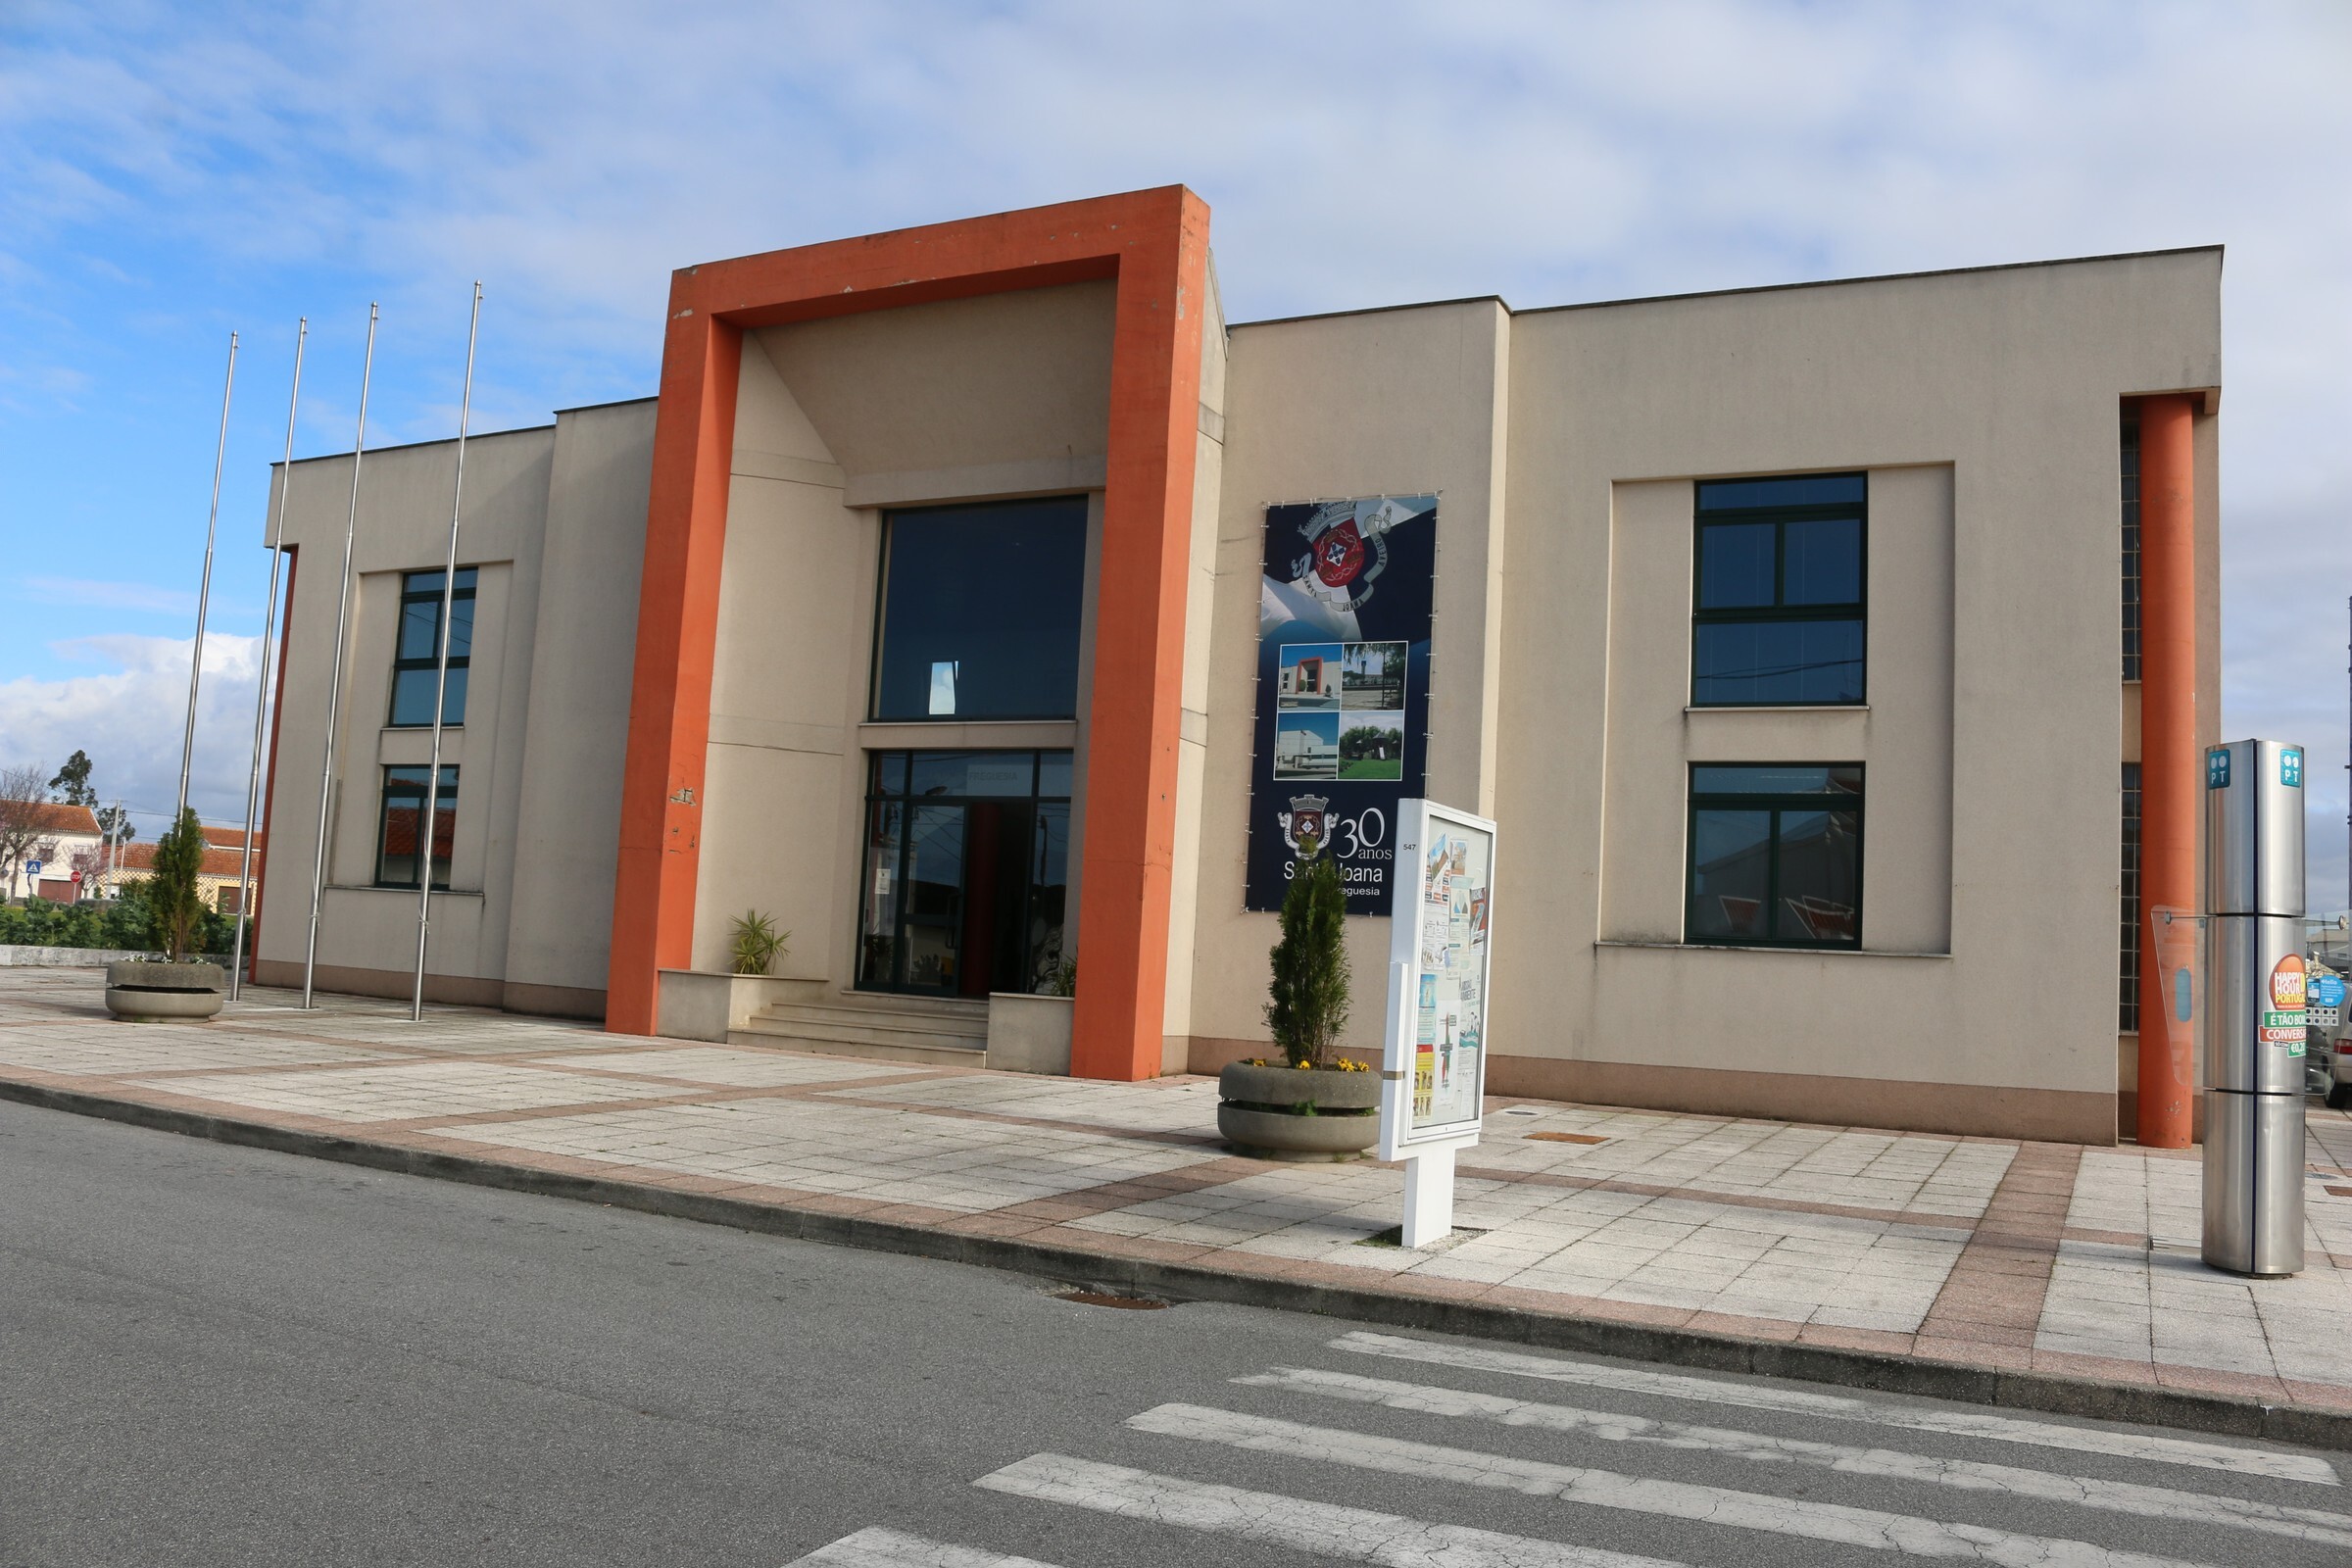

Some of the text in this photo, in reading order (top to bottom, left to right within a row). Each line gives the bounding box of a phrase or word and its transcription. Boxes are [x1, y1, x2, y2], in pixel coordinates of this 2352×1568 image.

[1343, 598, 1363, 612] JOANA
[968, 771, 1018, 781] FREGUESIA
[2211, 770, 2226, 784] PT
[2284, 769, 2298, 783] PT
[1337, 808, 1385, 858] 30
[1357, 848, 1393, 860] anos
[1337, 887, 1381, 897] eguesia
[2275, 972, 2300, 984] HAPPY
[2275, 983, 2300, 994] HOUR
[2276, 994, 2305, 1004] PORTUGA
[2270, 1013, 2277, 1025] É
[2278, 1013, 2293, 1025] TÃO
